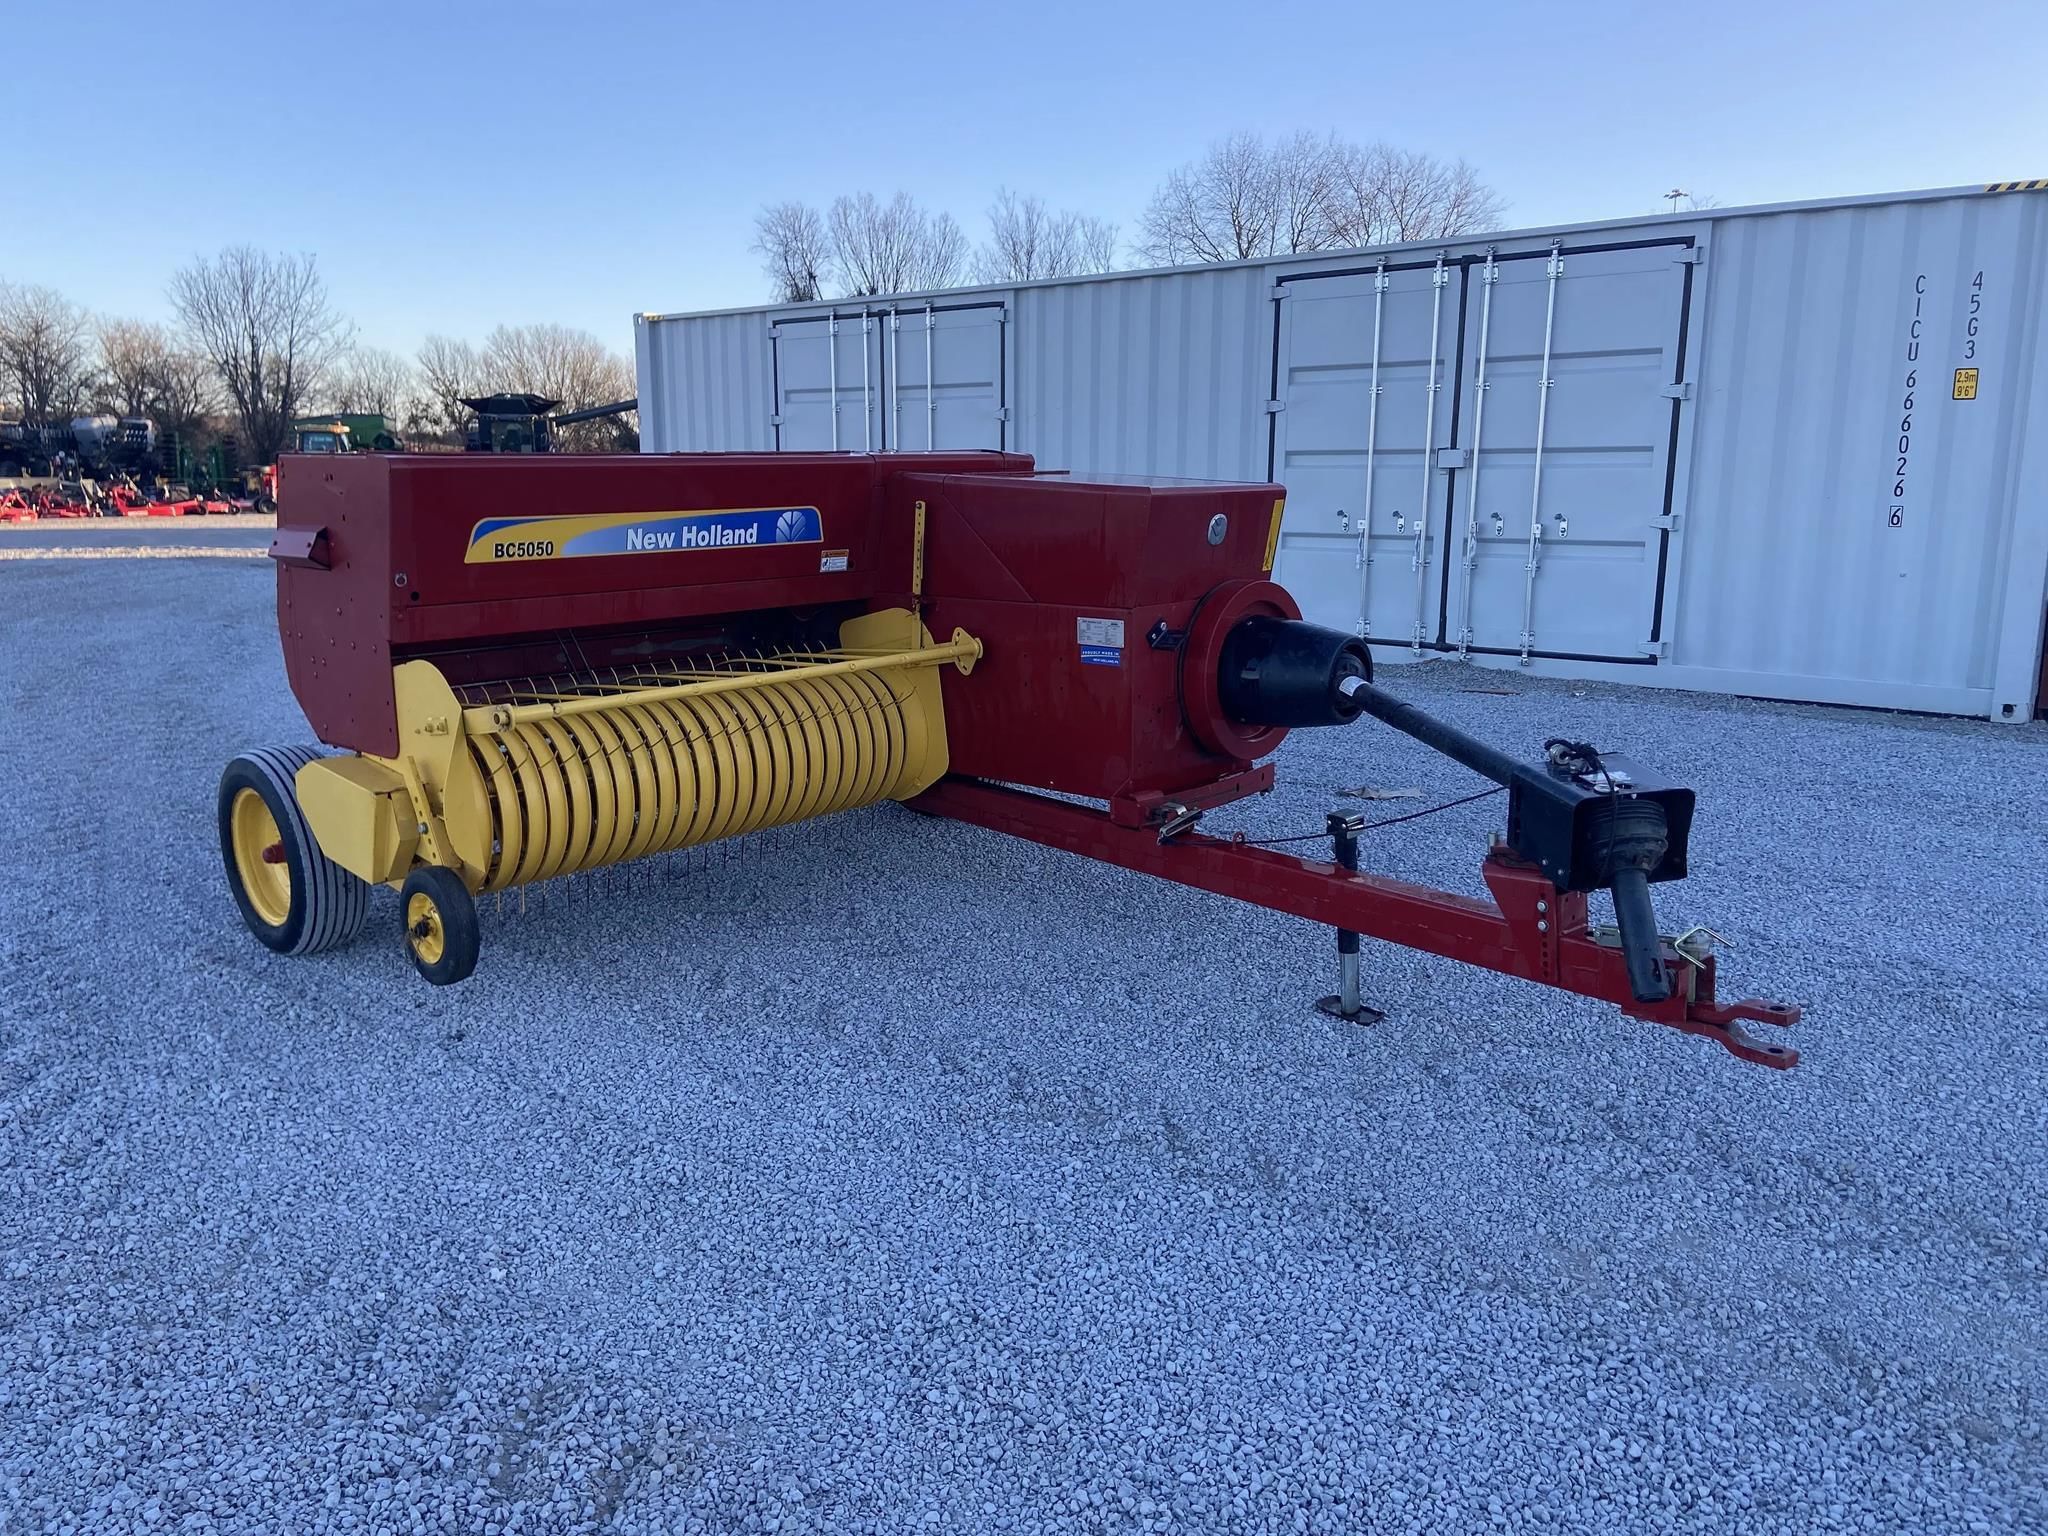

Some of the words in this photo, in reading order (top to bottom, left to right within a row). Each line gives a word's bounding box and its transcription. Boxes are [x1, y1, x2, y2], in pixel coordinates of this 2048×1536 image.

[1907, 275, 1926, 361] CICU
[1964, 271, 1984, 359] 45G3
[1893, 369, 1918, 498] 666026
[493, 541, 554, 558] BC5050
[626, 528, 676, 551] New
[681, 522, 758, 548] Holland
